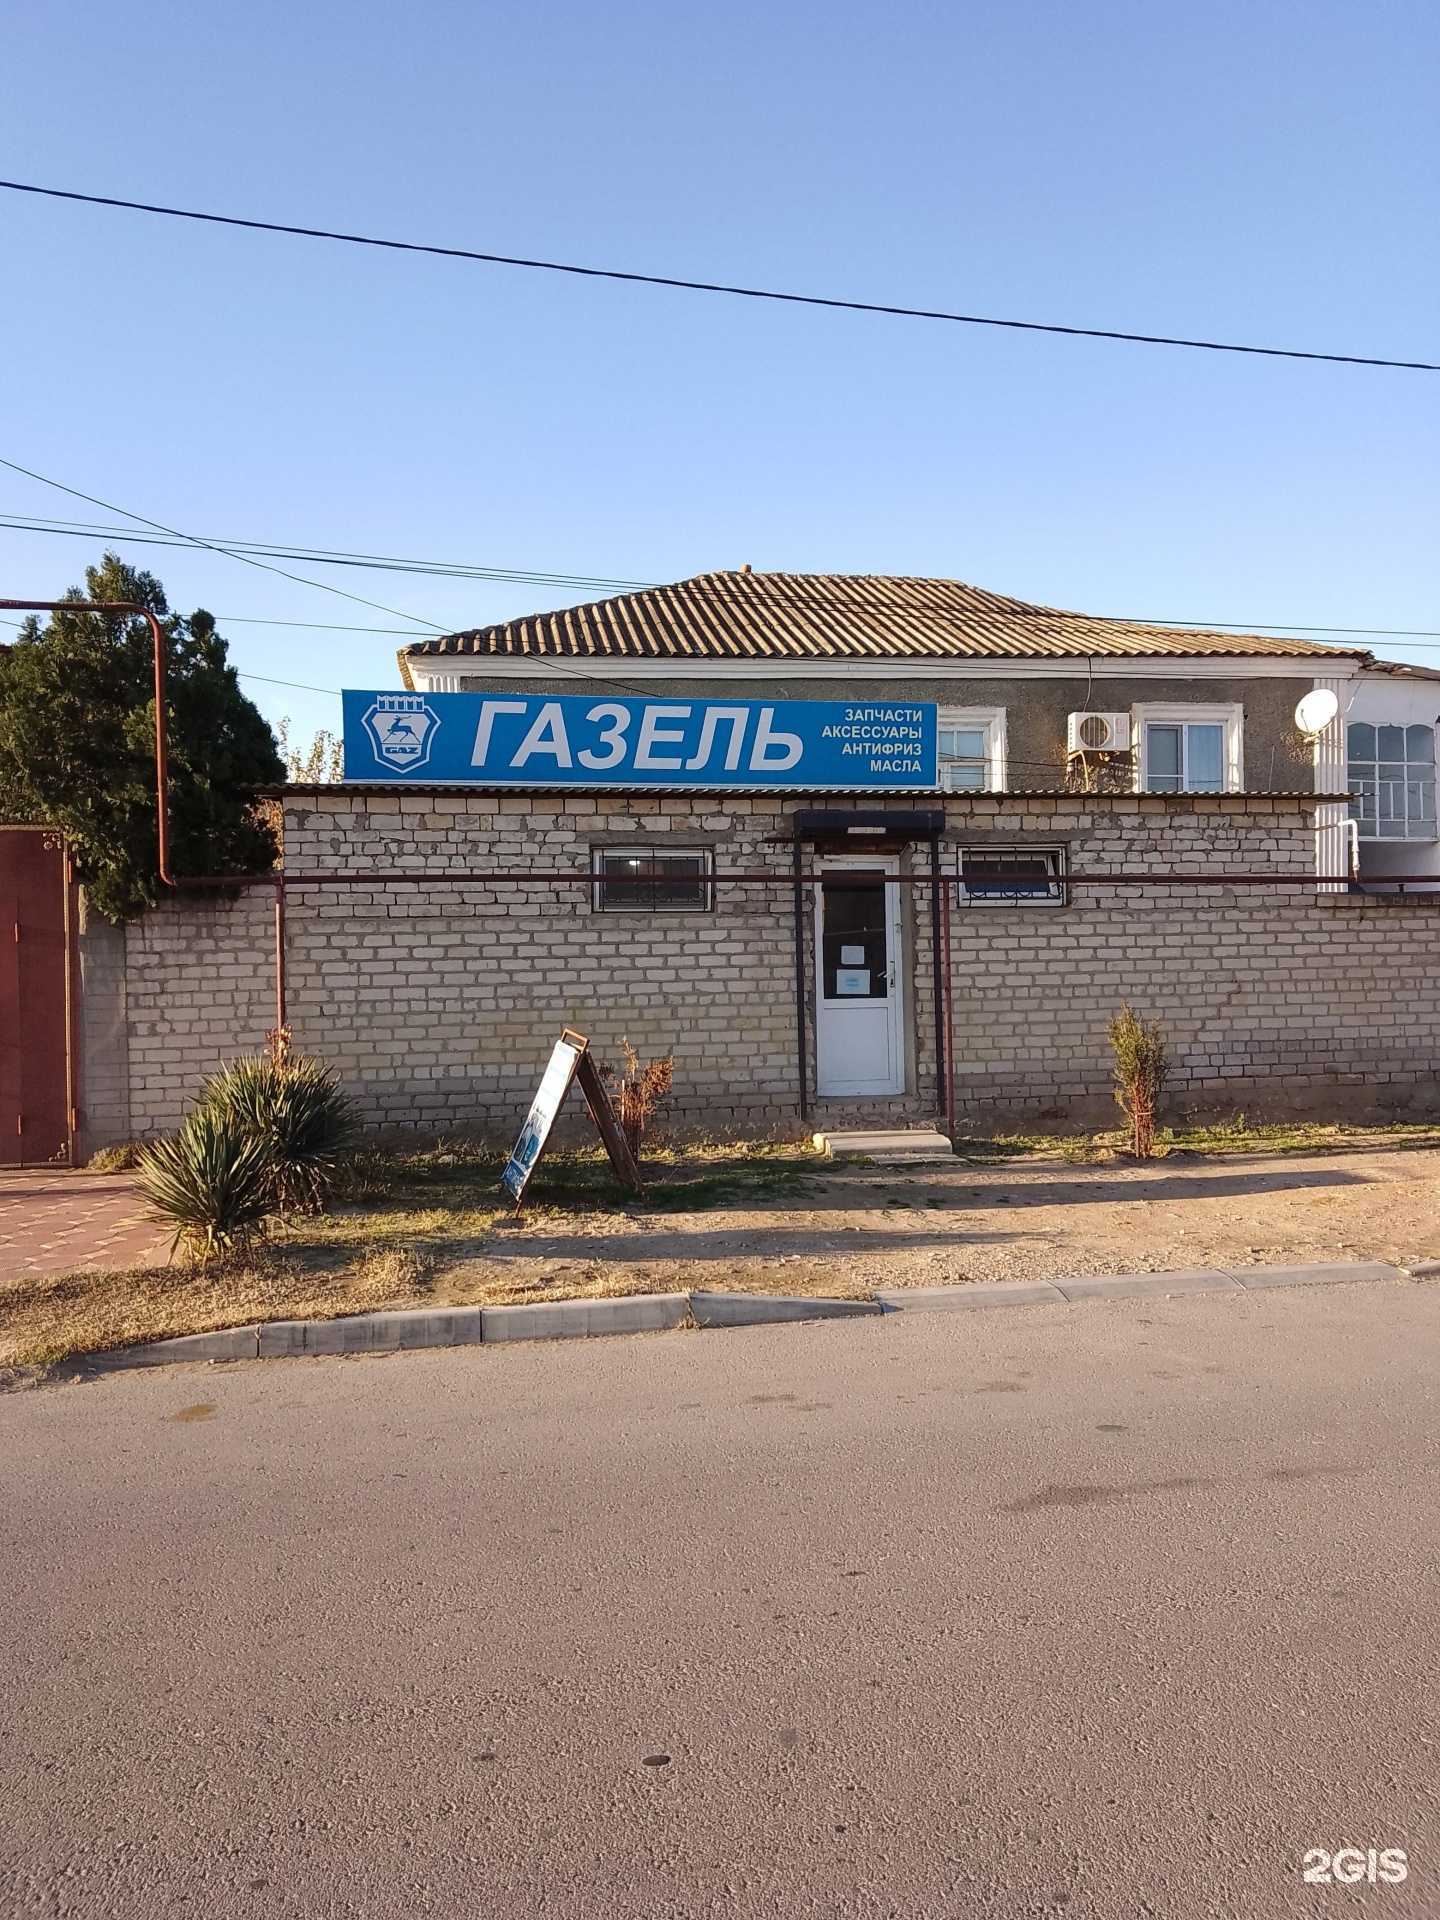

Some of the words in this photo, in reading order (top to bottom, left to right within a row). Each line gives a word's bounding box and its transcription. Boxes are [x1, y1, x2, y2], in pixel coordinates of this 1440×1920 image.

[844, 708, 923, 722] ЗАПЧАСТИ
[470, 700, 804, 771] ГАЗЕЛЬ
[821, 725, 922, 739] АКСЕССУАРЫ
[842, 742, 922, 756] АНТИФРИЗ
[870, 759, 922, 772] МАСЛА
